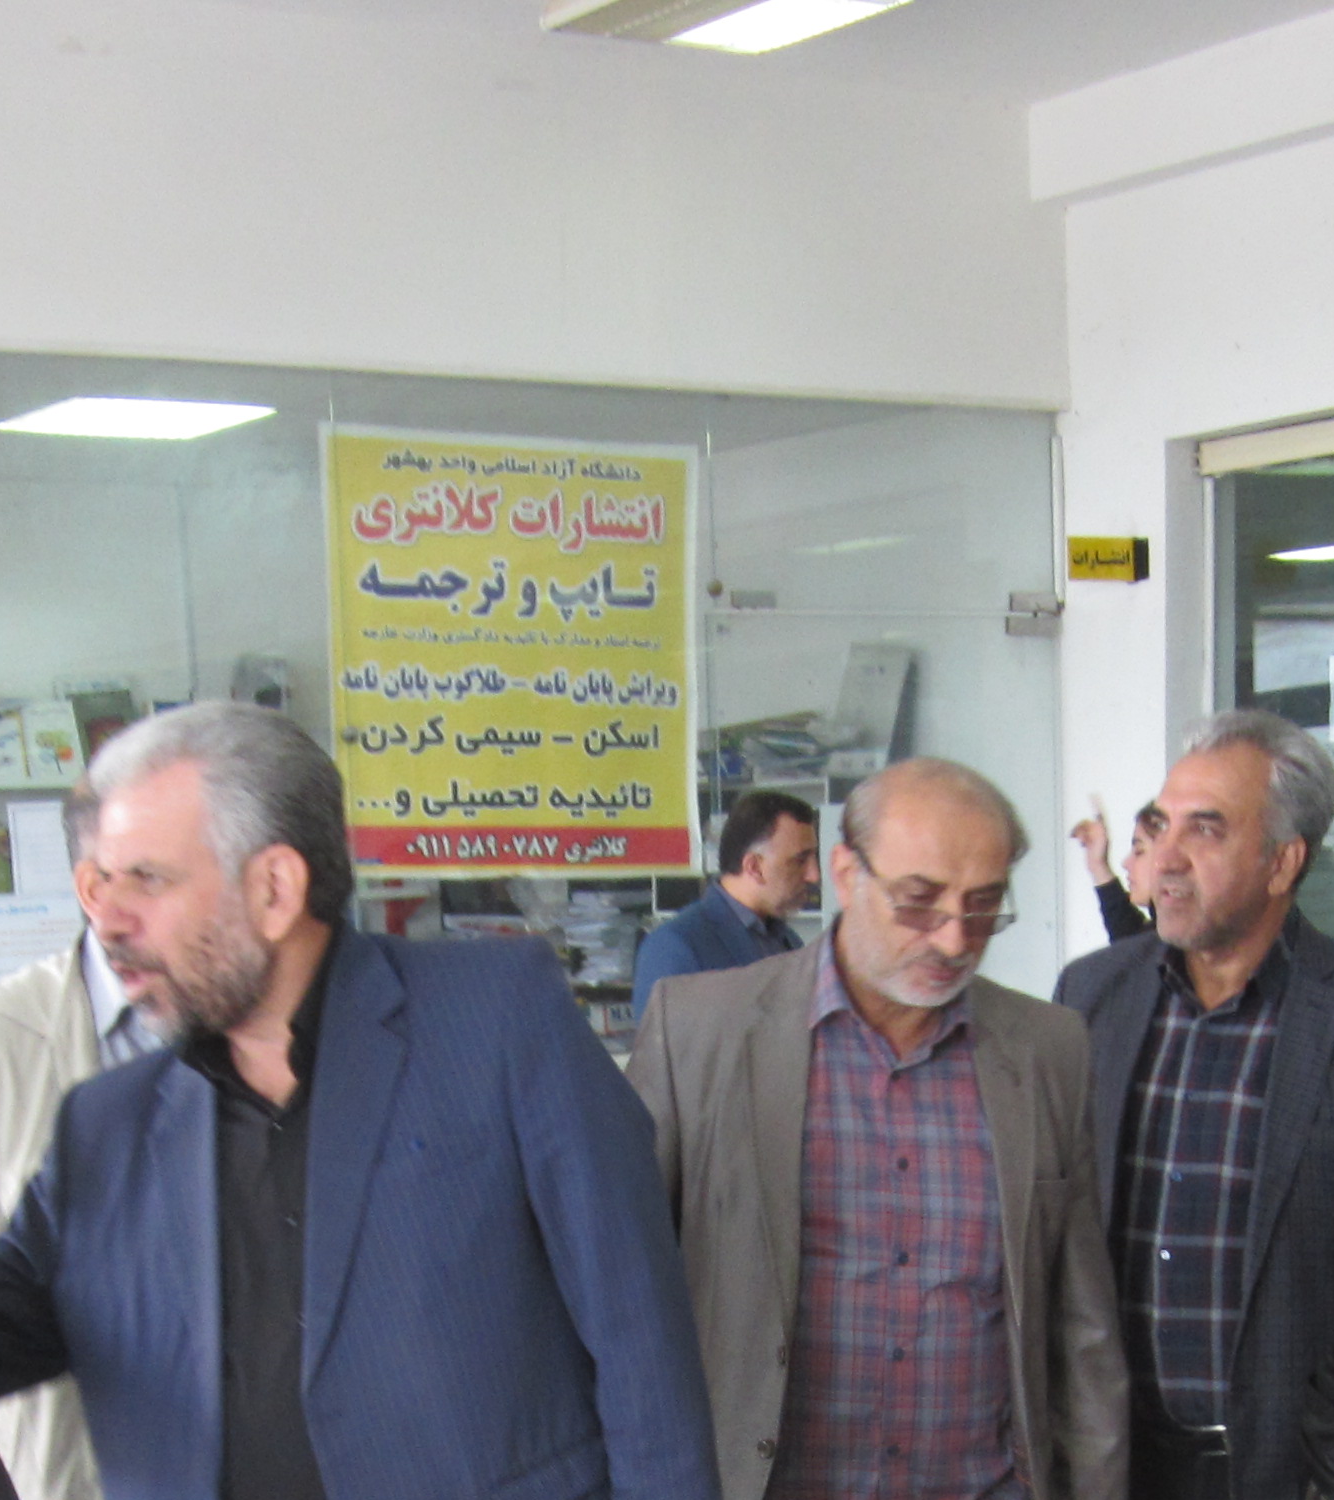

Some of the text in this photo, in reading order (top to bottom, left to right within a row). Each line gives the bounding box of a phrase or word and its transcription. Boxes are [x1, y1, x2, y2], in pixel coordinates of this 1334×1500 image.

[382, 449, 642, 481] دانشگاه آزاد اسلامی واحد بهشهر
[353, 484, 664, 551] انتشارات کلانتری
[360, 558, 656, 624] تایپ و ترجمه
[341, 663, 380, 692] نامه
[383, 664, 429, 700] پایان
[433, 666, 507, 701] طلاکوب
[532, 667, 567, 695] نامه
[572, 671, 614, 705] پایان
[619, 674, 679, 707] ویرایش
[360, 715, 445, 755] کردن
[455, 725, 542, 756] سیمی
[583, 721, 659, 757] اسکن
[422, 780, 539, 818] تحصیلی
[549, 783, 652, 818] تائیدیه
[565, 836, 627, 863] کلانتری
